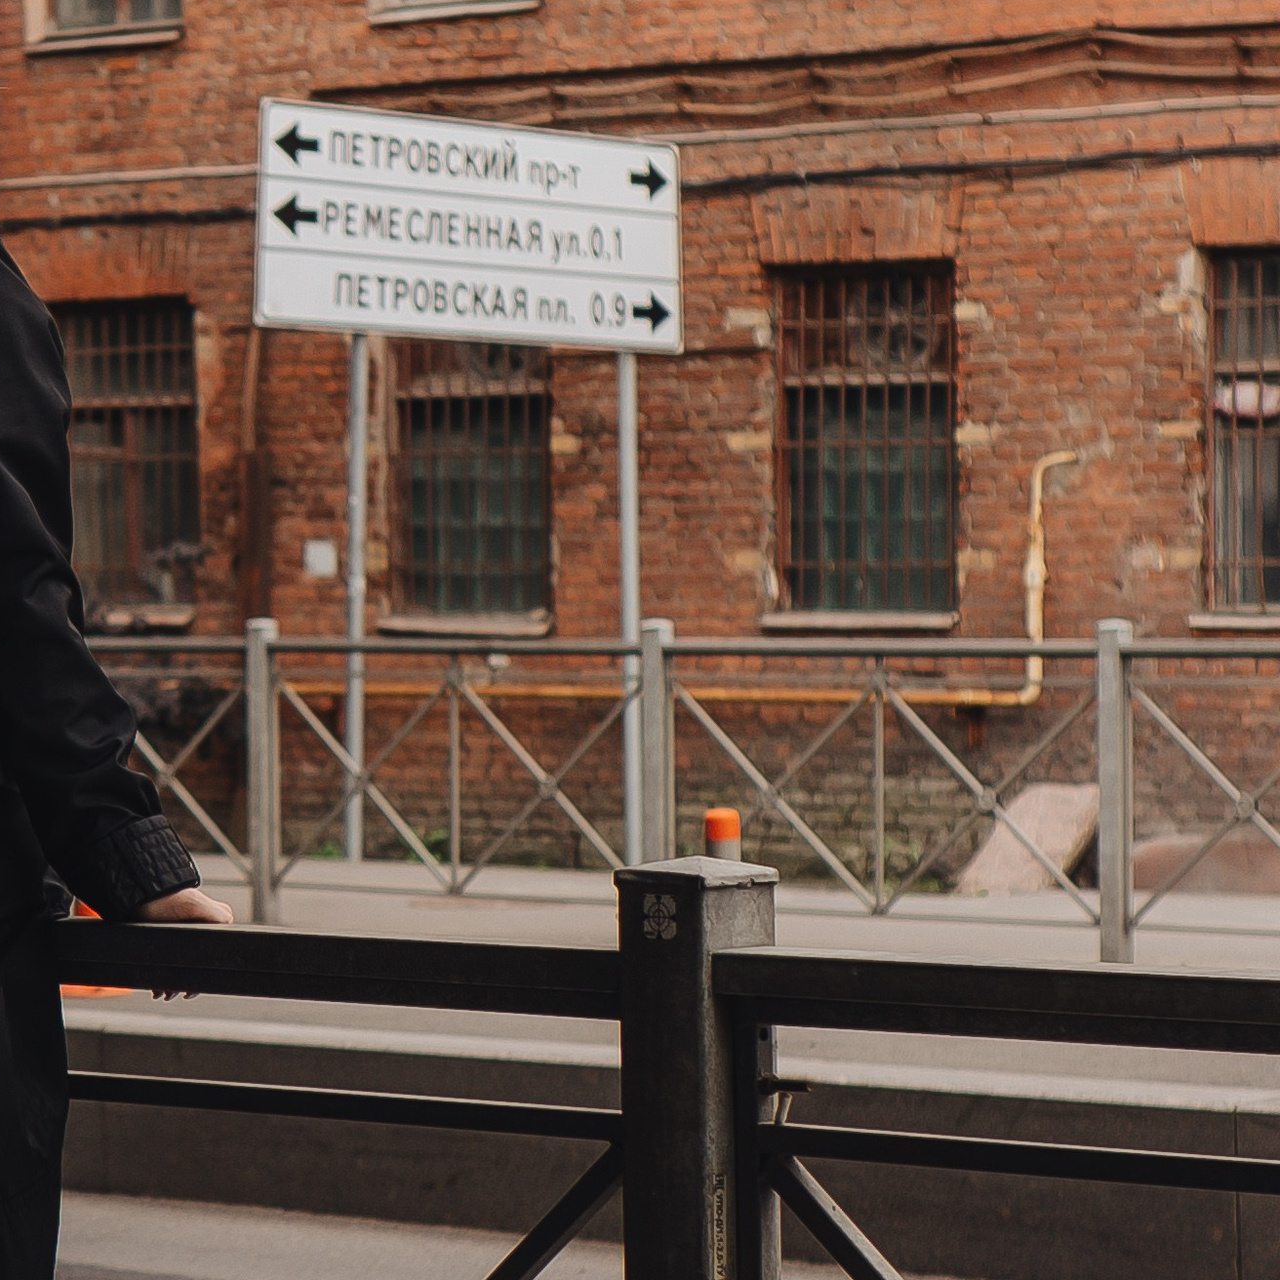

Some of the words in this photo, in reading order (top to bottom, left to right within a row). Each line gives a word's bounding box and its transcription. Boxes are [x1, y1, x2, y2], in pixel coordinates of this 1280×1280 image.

[330, 130, 519, 182] ПЕТРОВСКИЙ
[528, 160, 582, 196] пр-т
[322, 200, 543, 255] РЕМЕСЛЕННАЯ
[334, 271, 529, 321] ПЕТРОВСКАЯ
